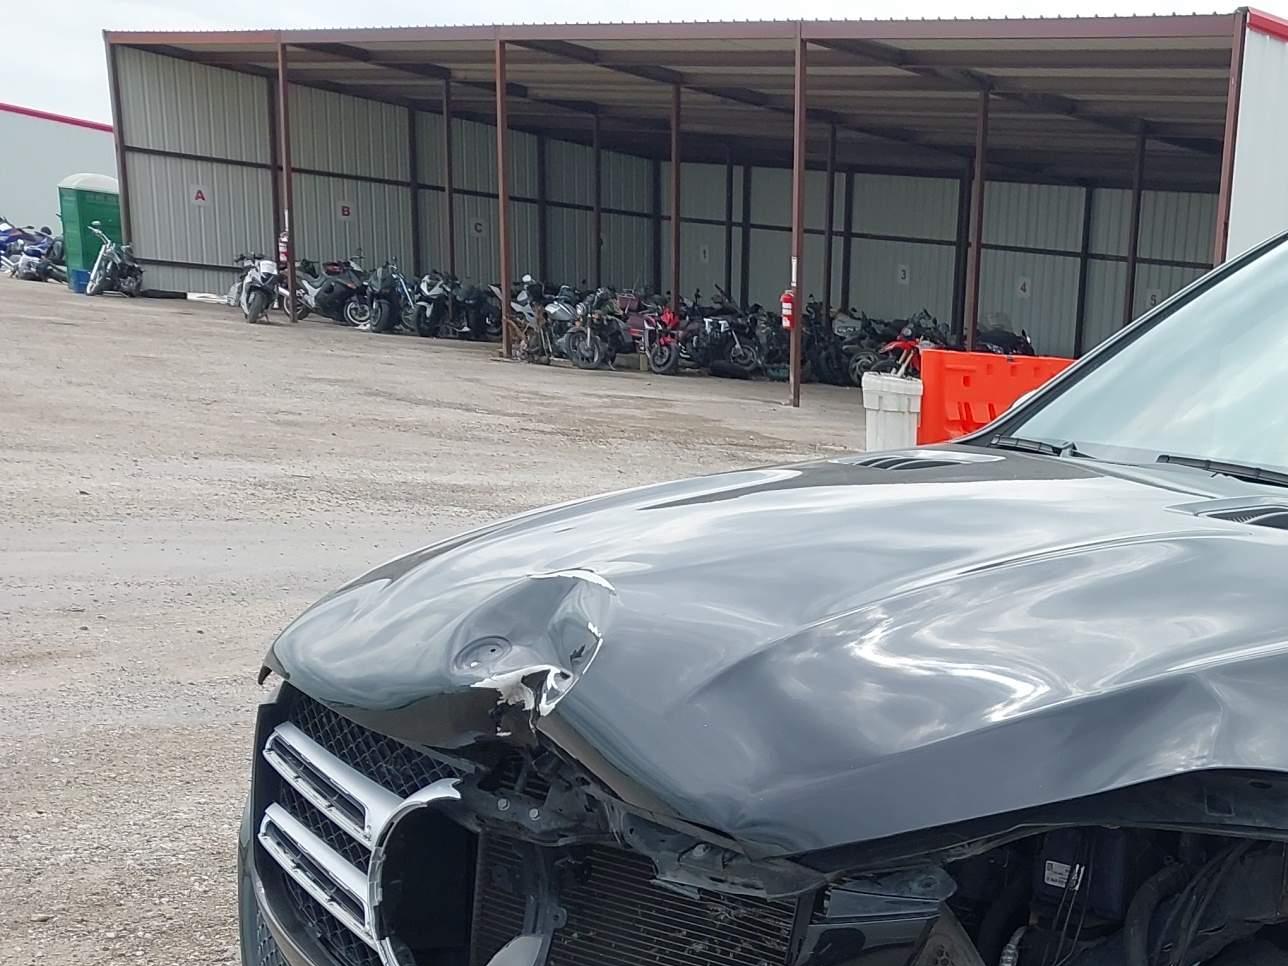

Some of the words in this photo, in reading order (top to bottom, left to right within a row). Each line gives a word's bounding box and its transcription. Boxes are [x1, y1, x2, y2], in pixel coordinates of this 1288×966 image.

[194, 189, 206, 201] A
[341, 205, 351, 217] B
[474, 222, 483, 233] C
[900, 268, 907, 280] 3
[1020, 280, 1028, 294] 4
